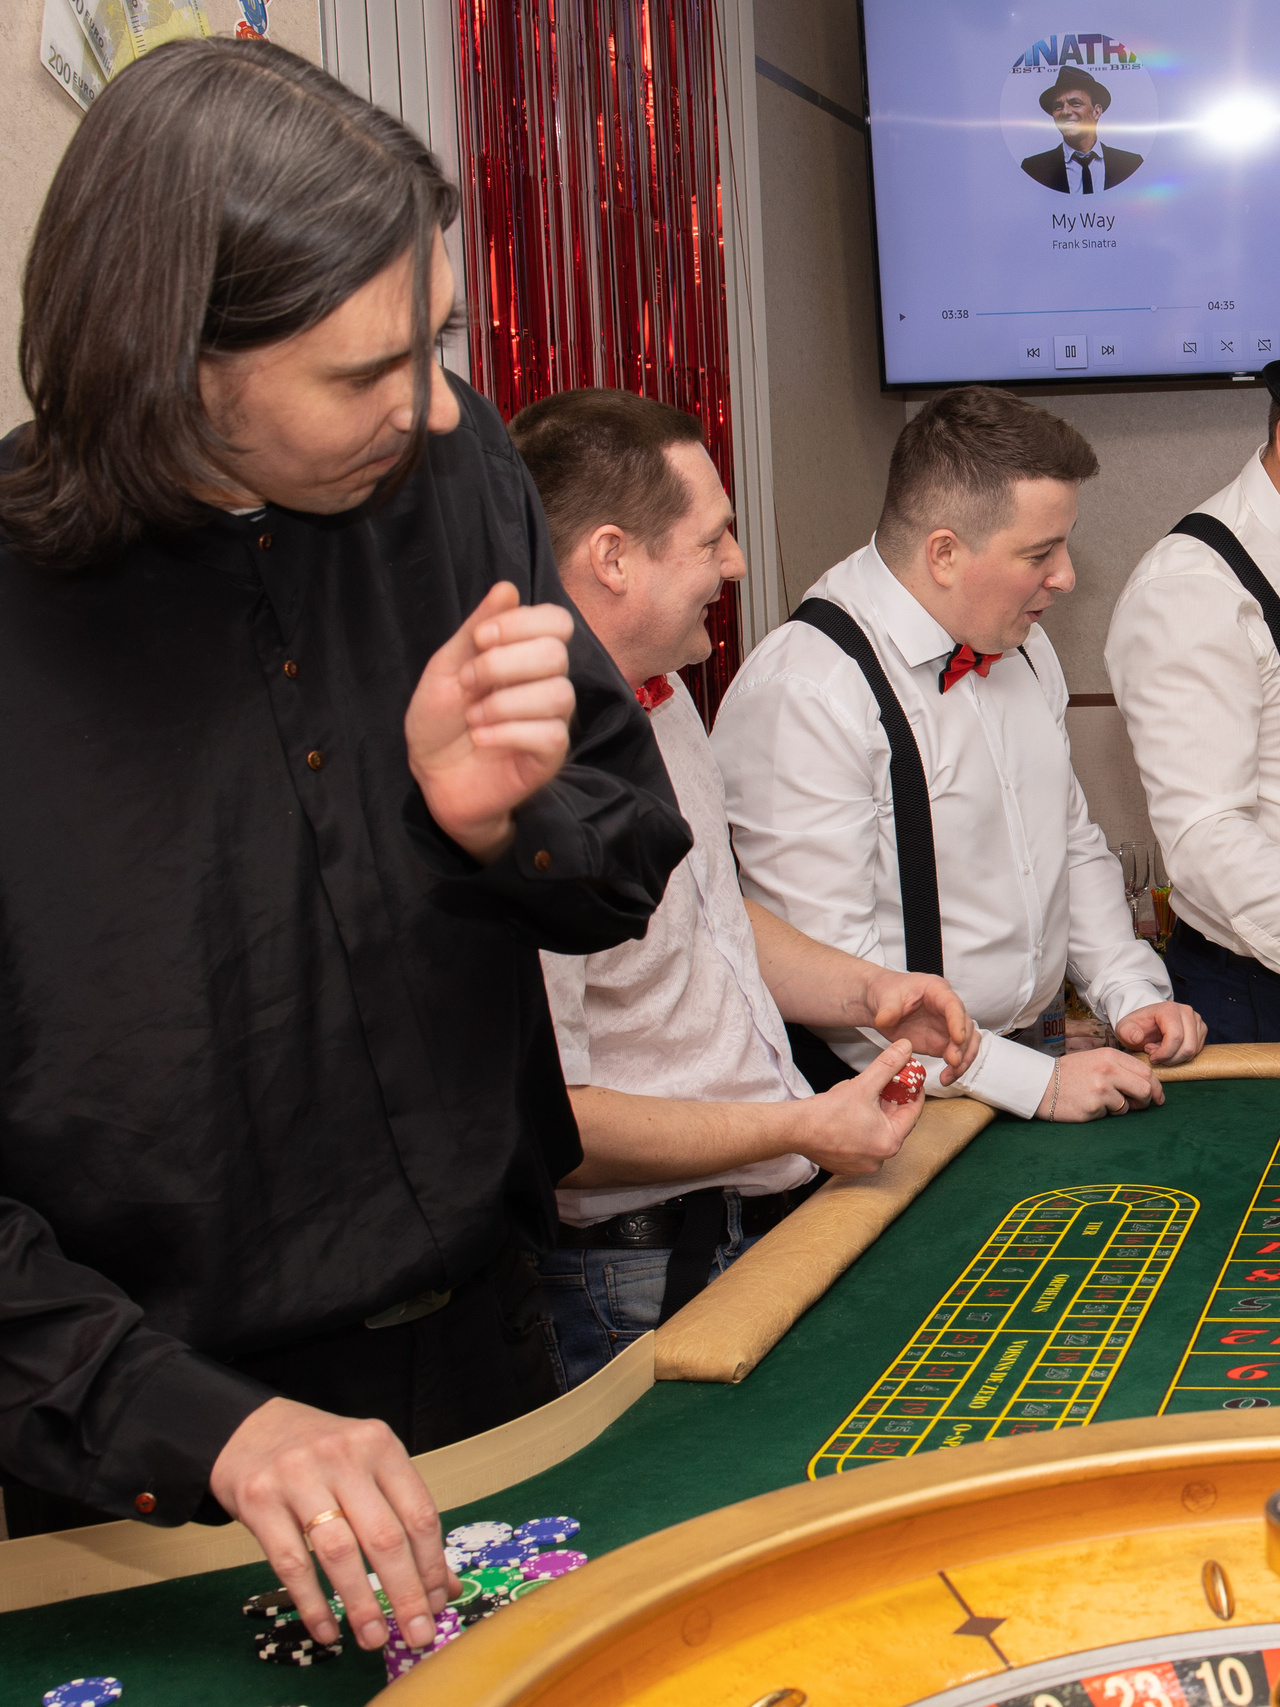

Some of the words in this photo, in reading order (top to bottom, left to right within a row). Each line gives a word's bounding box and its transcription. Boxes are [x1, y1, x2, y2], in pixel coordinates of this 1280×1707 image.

[84, 11, 105, 49] EURO
[48, 45, 72, 84] 200
[72, 70, 95, 101] EURO
[1052, 213, 1077, 233] My
[1080, 212, 1116, 232] Way
[1052, 239, 1080, 250] Frank
[1082, 238, 1117, 249] Sinatra
[942, 309, 969, 319] 03:38
[1208, 300, 1235, 311] 04:35
[1081, 1221, 1103, 1236] TIER
[1031, 1273, 1070, 1313] ORPHELINS
[994, 1340, 1029, 1372] VOISINS
[985, 1371, 1009, 1384] DE
[968, 1385, 999, 1410] ZERO
[1195, 1657, 1254, 1707] 10
